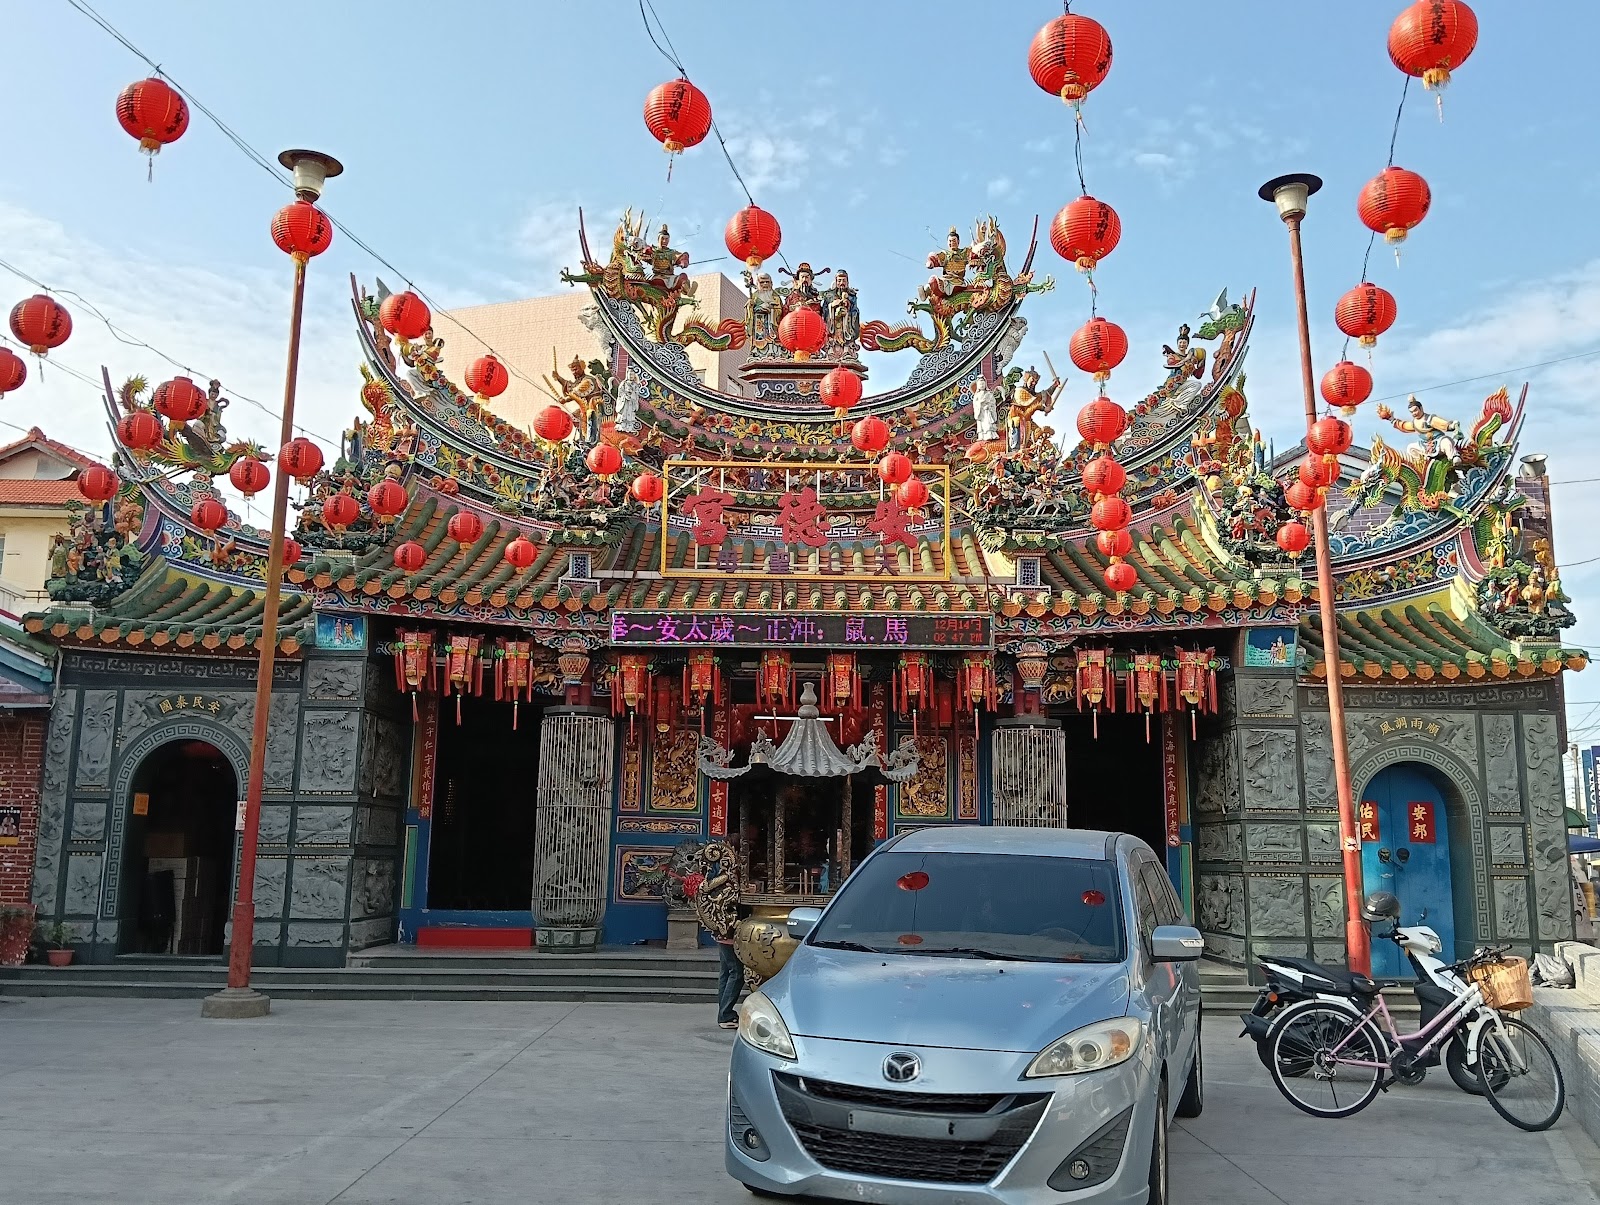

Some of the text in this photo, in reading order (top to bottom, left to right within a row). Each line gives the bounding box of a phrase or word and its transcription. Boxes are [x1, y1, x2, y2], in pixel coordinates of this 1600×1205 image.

[969, 632, 983, 643] PM
[159, 694, 221, 714] 國泰民安
[1379, 716, 1441, 737] 風調雨順
[1360, 802, 1376, 840] 佑民
[1411, 803, 1428, 840] 安邦
